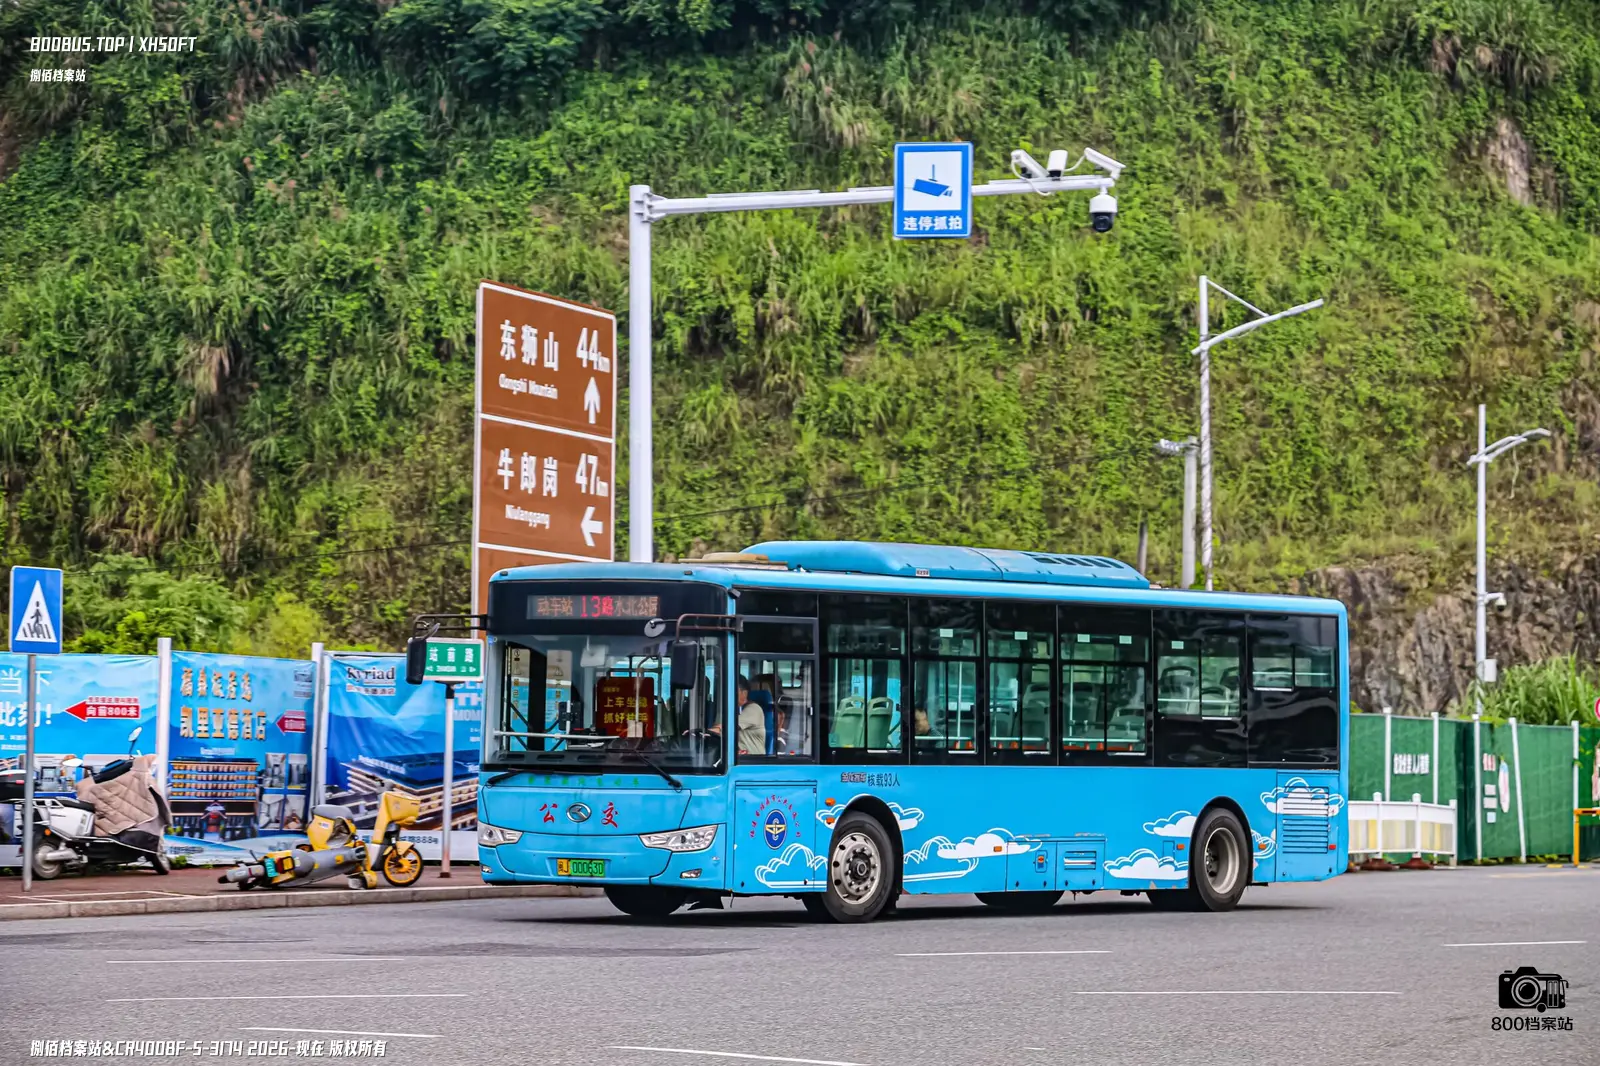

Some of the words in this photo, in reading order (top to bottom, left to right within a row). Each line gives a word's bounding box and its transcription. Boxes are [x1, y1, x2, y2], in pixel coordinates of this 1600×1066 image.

[903, 215, 962, 231] 违停抓拍
[500, 319, 559, 371] 东狮山
[497, 448, 558, 497] 牛郎岗
[537, 596, 573, 616] 动车站
[346, 666, 396, 683] Kyriad
